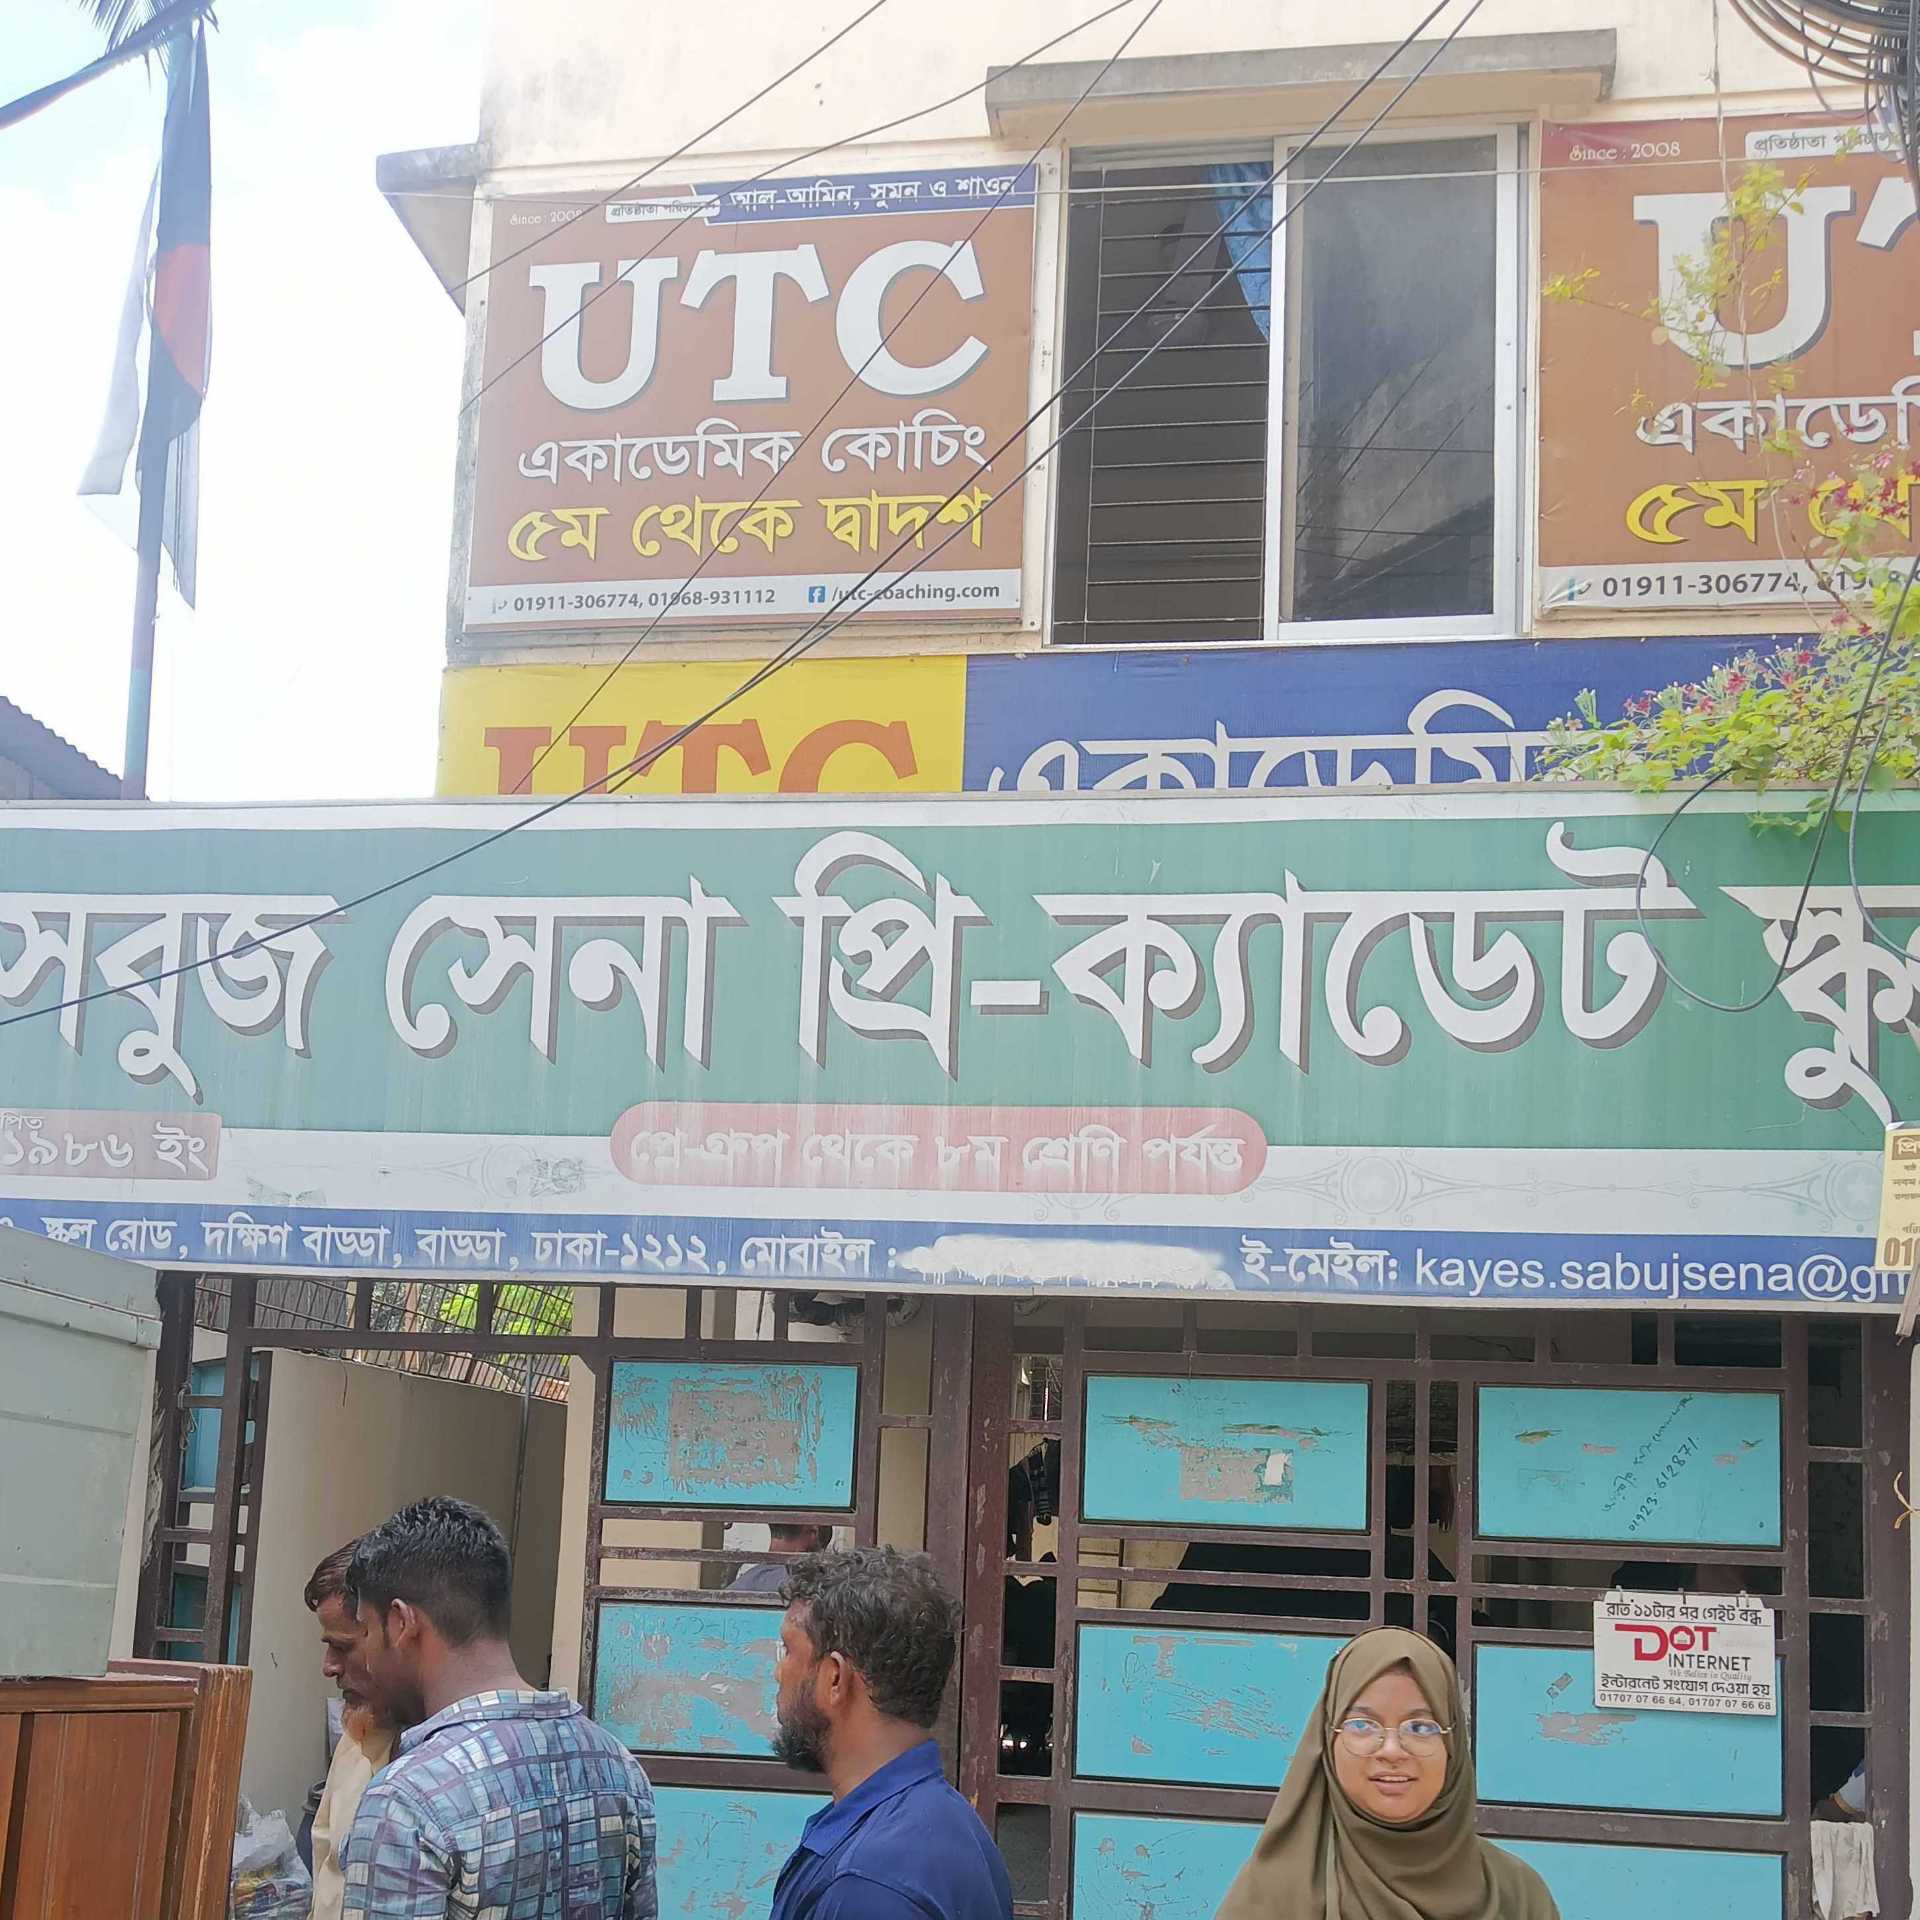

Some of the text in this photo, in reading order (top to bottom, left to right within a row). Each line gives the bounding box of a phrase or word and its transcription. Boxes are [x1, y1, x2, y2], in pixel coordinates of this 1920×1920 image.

[1569, 144, 1618, 162] Since
[1631, 142, 1681, 159] 2008
[869, 181, 922, 209] সুমন
[929, 180, 948, 197] ও
[955, 175, 1018, 200] শাওন
[528, 240, 989, 410] UTC
[518, 408, 993, 484] একাডেমিক কোচিং
[507, 486, 994, 560] ৫ম থেকে দ্বাদশ
[1626, 479, 1771, 544] ৫ম
[514, 582, 1001, 613] 01911-306774, 01968-931112 /utc-coaching.com
[1602, 571, 1809, 597] 01911-306774,
[0, 821, 1920, 1129] সবুজ সেনা প্রি-ক্যাডেট স্কু
[152, 1121, 209, 1178] ইং
[803, 1118, 920, 1178] থেকে
[935, 1134, 1009, 1178] ৮ম
[1143, 1123, 1248, 1180] পর্যন্ত
[200, 1211, 293, 1263] দক্ষিণ
[531, 1228, 726, 1275] ঢাকা-১২১২,
[1606, 1601, 1762, 1626] রাত ১১টার পর গেইট বন্ধ
[1615, 1623, 1717, 1661] DOT
[1668, 1653, 1751, 1672] INTERNET
[1600, 1693, 1633, 1704] 01707
[1636, 1694, 1648, 1704] 07
[1651, 1695, 1666, 1705] 66
[1688, 1697, 1721, 1708] 01707
[1724, 1698, 1737, 1709] 07
[1741, 1699, 1755, 1710] 66
[1758, 1700, 1771, 1711] 68
[1601, 1673, 1770, 1697] ইন্টারনেট সংযোগ দেওয়া হয়
